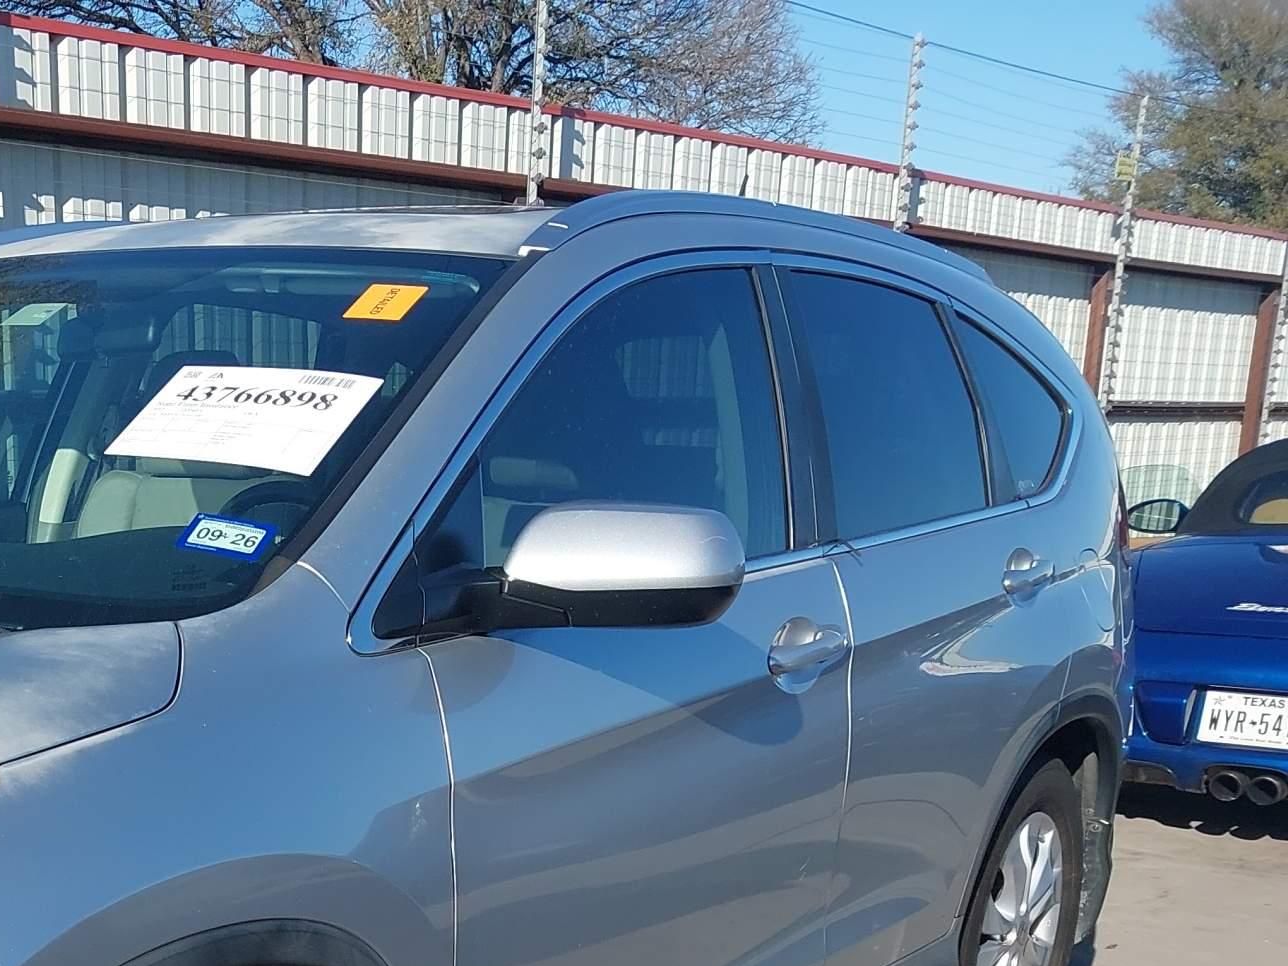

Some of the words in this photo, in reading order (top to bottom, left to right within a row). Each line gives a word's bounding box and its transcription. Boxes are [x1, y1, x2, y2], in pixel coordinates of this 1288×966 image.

[369, 287, 401, 315] DETAILED
[175, 384, 339, 411] 43766898
[196, 527, 224, 542] 09
[230, 532, 259, 549] 26
[1242, 696, 1286, 709] TEXAS
